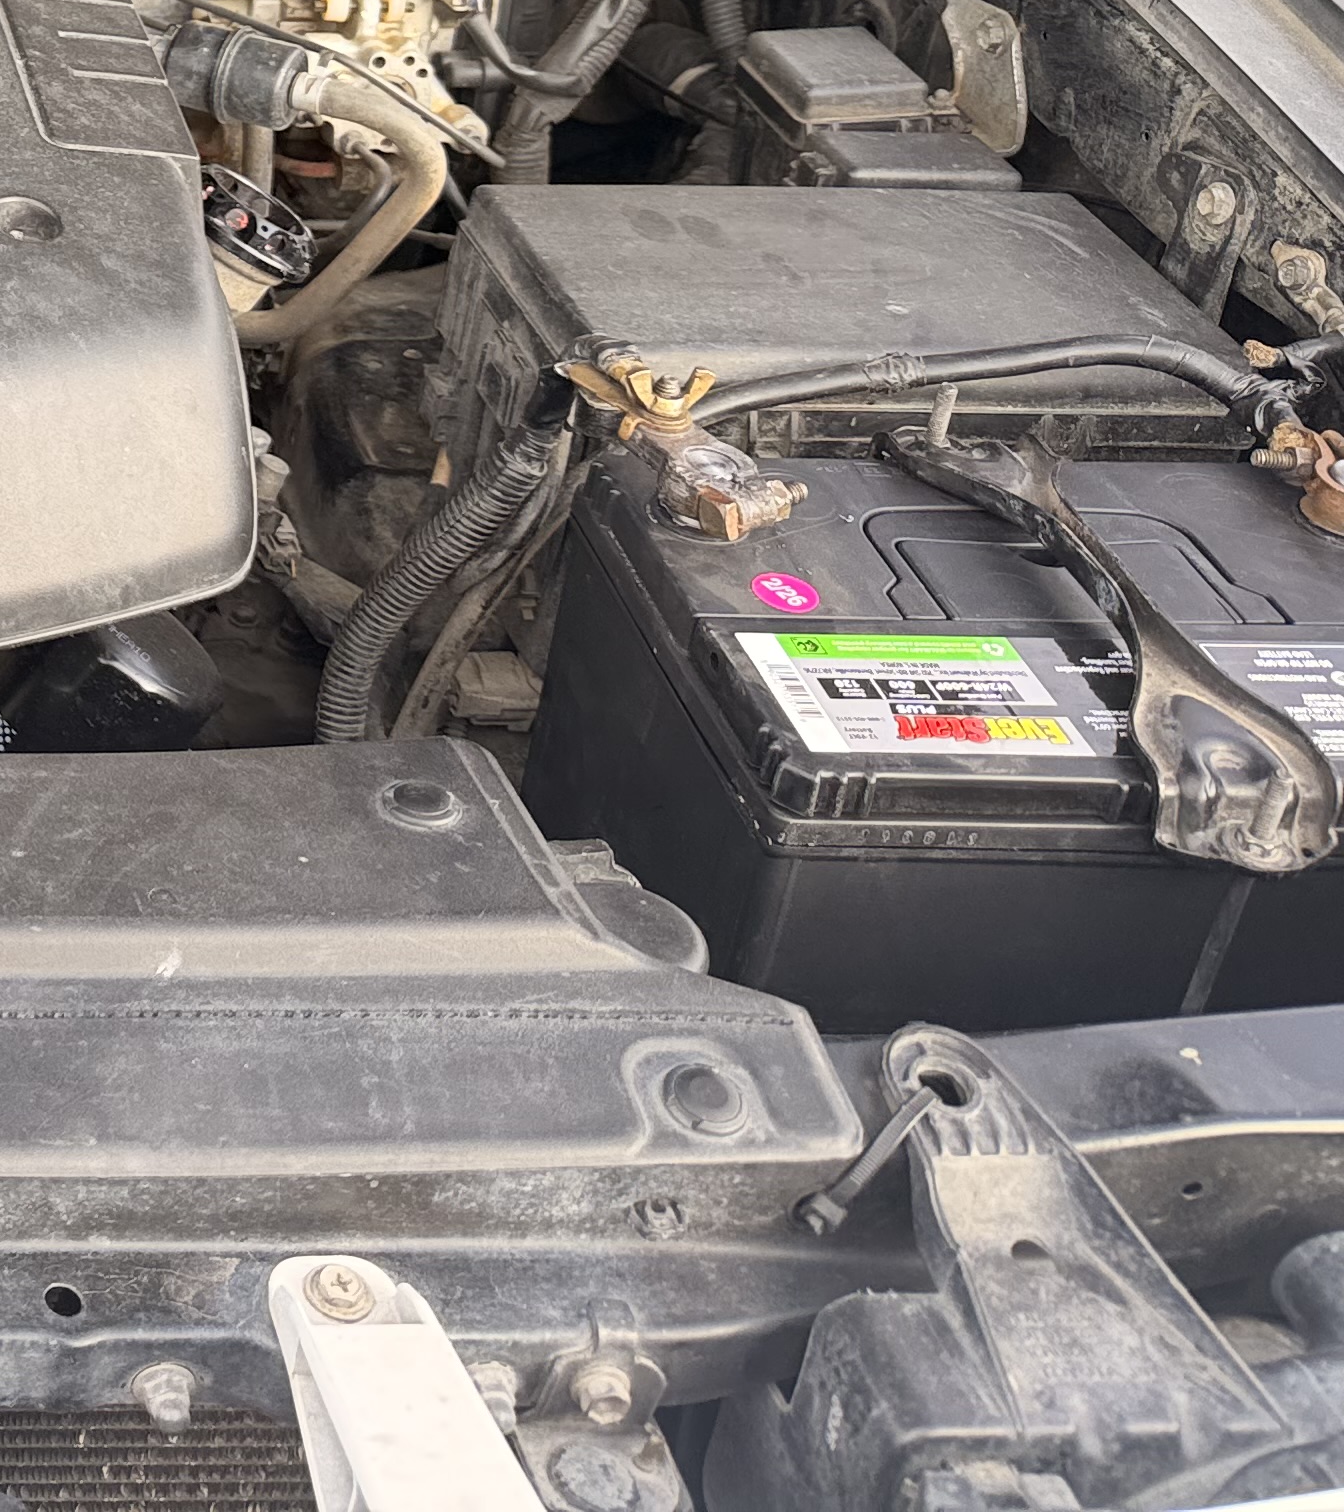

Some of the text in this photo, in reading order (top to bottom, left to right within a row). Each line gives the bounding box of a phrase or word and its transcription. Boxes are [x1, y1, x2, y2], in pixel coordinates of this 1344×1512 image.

[759, 577, 809, 606] 2/26
[895, 703, 936, 714] PLUS
[896, 717, 1072, 746] EverStart
